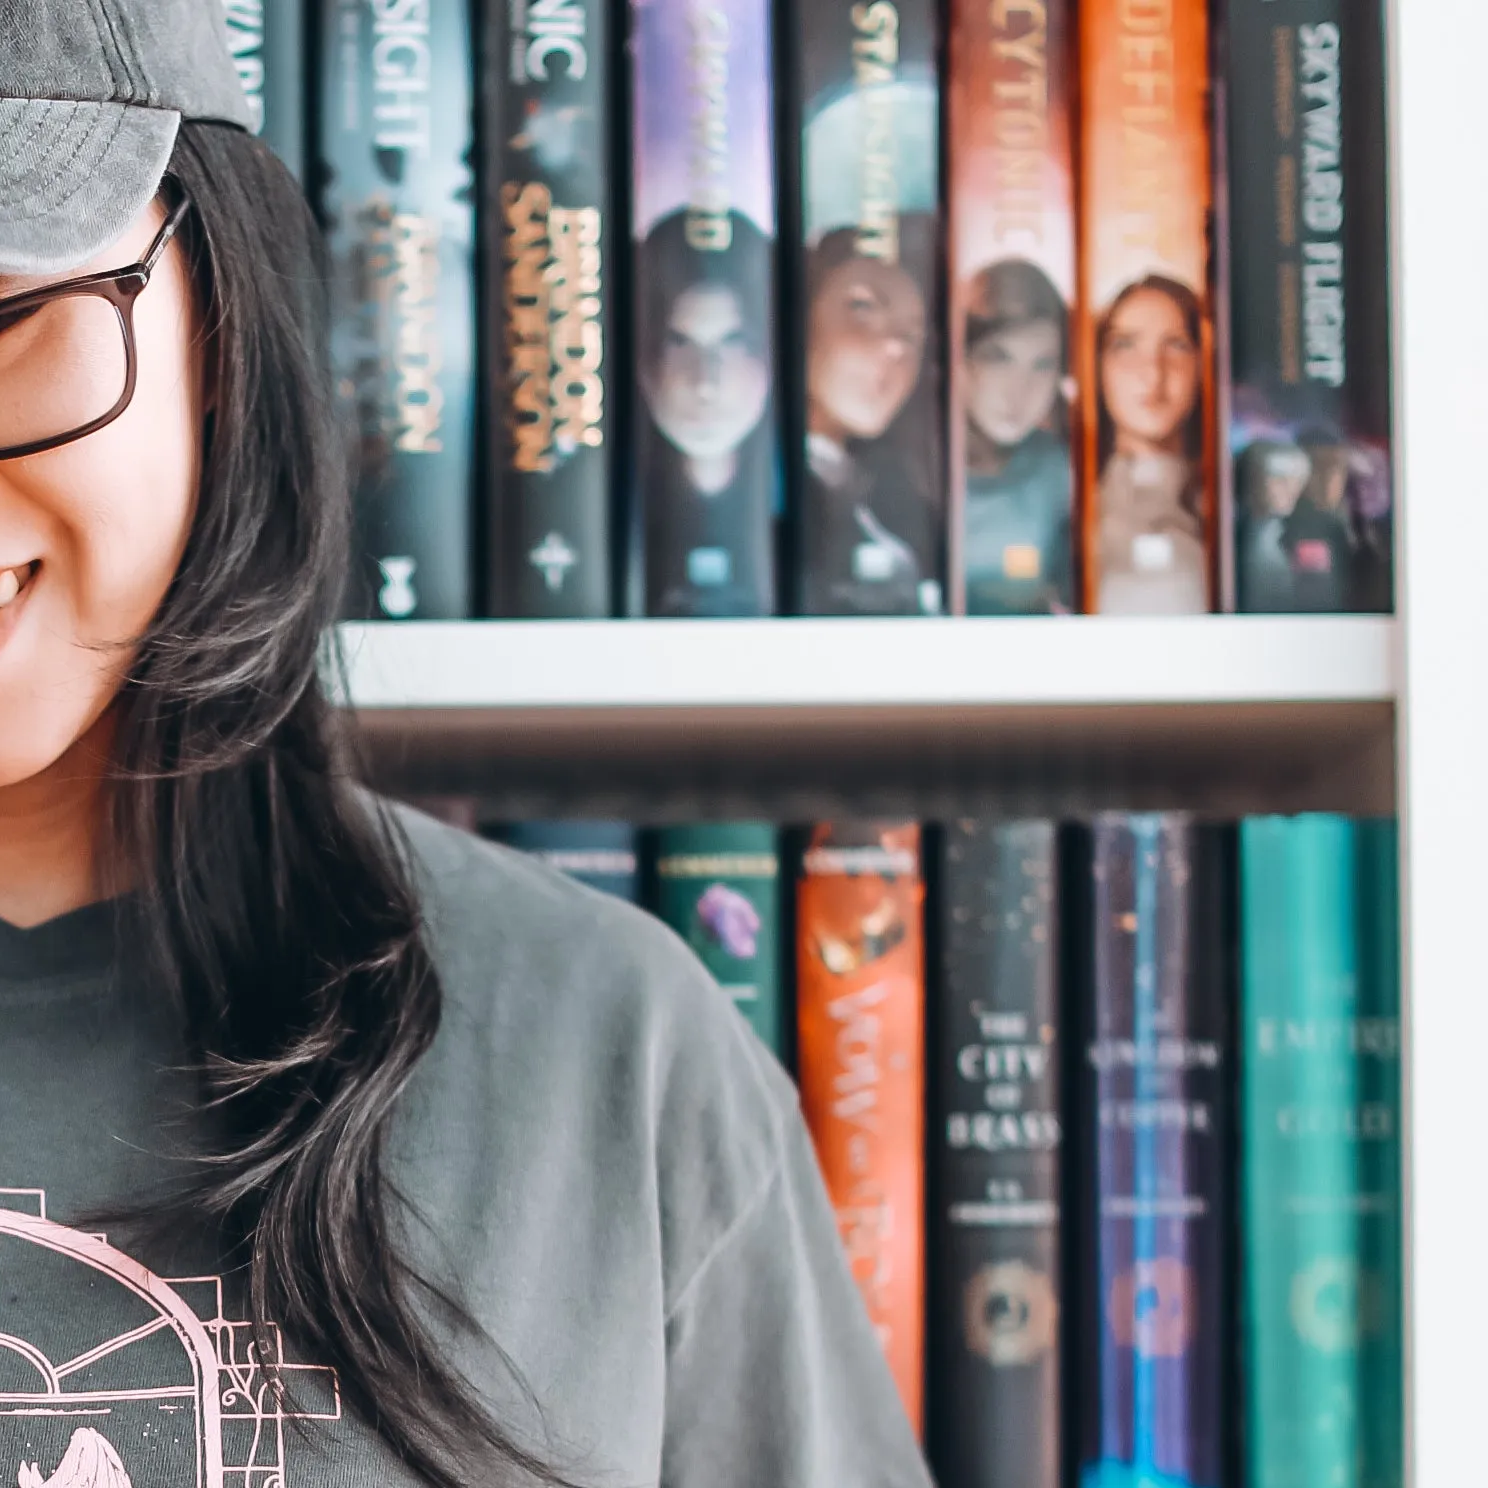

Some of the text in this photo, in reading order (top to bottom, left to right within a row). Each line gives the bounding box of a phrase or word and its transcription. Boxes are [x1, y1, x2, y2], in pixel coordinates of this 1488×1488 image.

[990, 0, 1048, 247] CYTONIC
[1298, 21, 1345, 387] SKYWARD FLIGHT
[947, 1112, 1061, 1150] BRASS
[958, 1044, 1050, 1081] CITY
